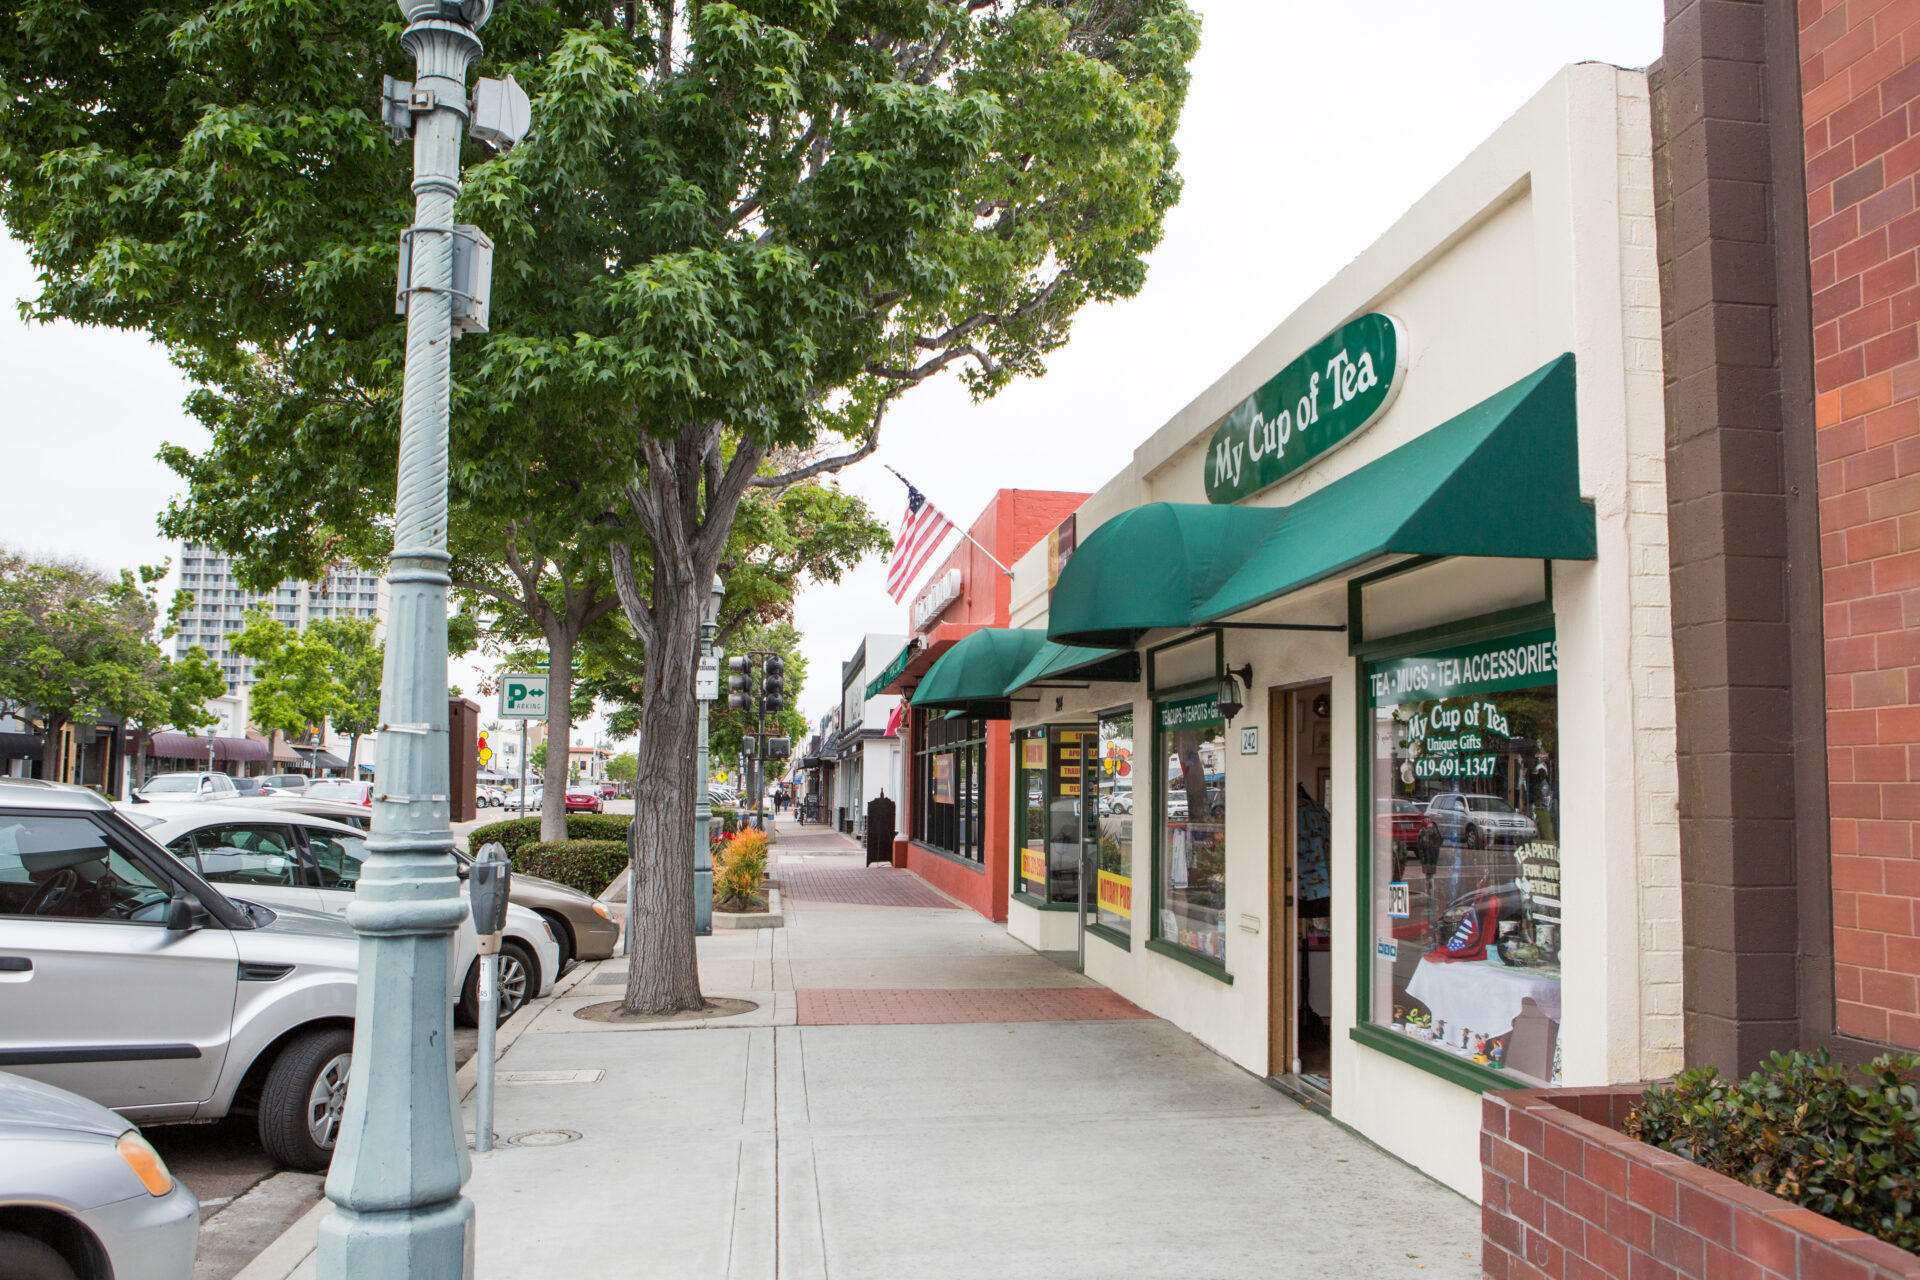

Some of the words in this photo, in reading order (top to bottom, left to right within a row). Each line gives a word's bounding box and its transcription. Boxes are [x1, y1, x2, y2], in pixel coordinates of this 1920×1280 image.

[1213, 436, 1245, 488] My
[1248, 409, 1291, 463] Cup
[1296, 371, 1320, 432] of
[1326, 348, 1378, 410] Tea
[1370, 672, 1391, 697] TEA
[1396, 665, 1429, 694] MUGS
[1437, 659, 1461, 687] TEA
[1462, 641, 1559, 684] ACCESSORIES
[1161, 706, 1183, 726] TEACUPS
[1184, 702, 1208, 723] TEAPOTS
[1407, 712, 1428, 742] My
[1430, 704, 1461, 732] Cup
[1464, 702, 1480, 726] of
[1483, 702, 1510, 737] Tea
[1243, 732, 1256, 750] 242
[1427, 737, 1457, 754] Unique
[1459, 734, 1482, 750] Gifts
[1415, 757, 1496, 777] 619-691-1347
[1514, 843, 1533, 865] TEA
[1522, 864, 1541, 877] FOR
[1542, 865, 1560, 881] ANY
[1100, 878, 1119, 906] NOTARY
[1529, 880, 1560, 896] EVENT
[1388, 886, 1408, 914] OPEN
